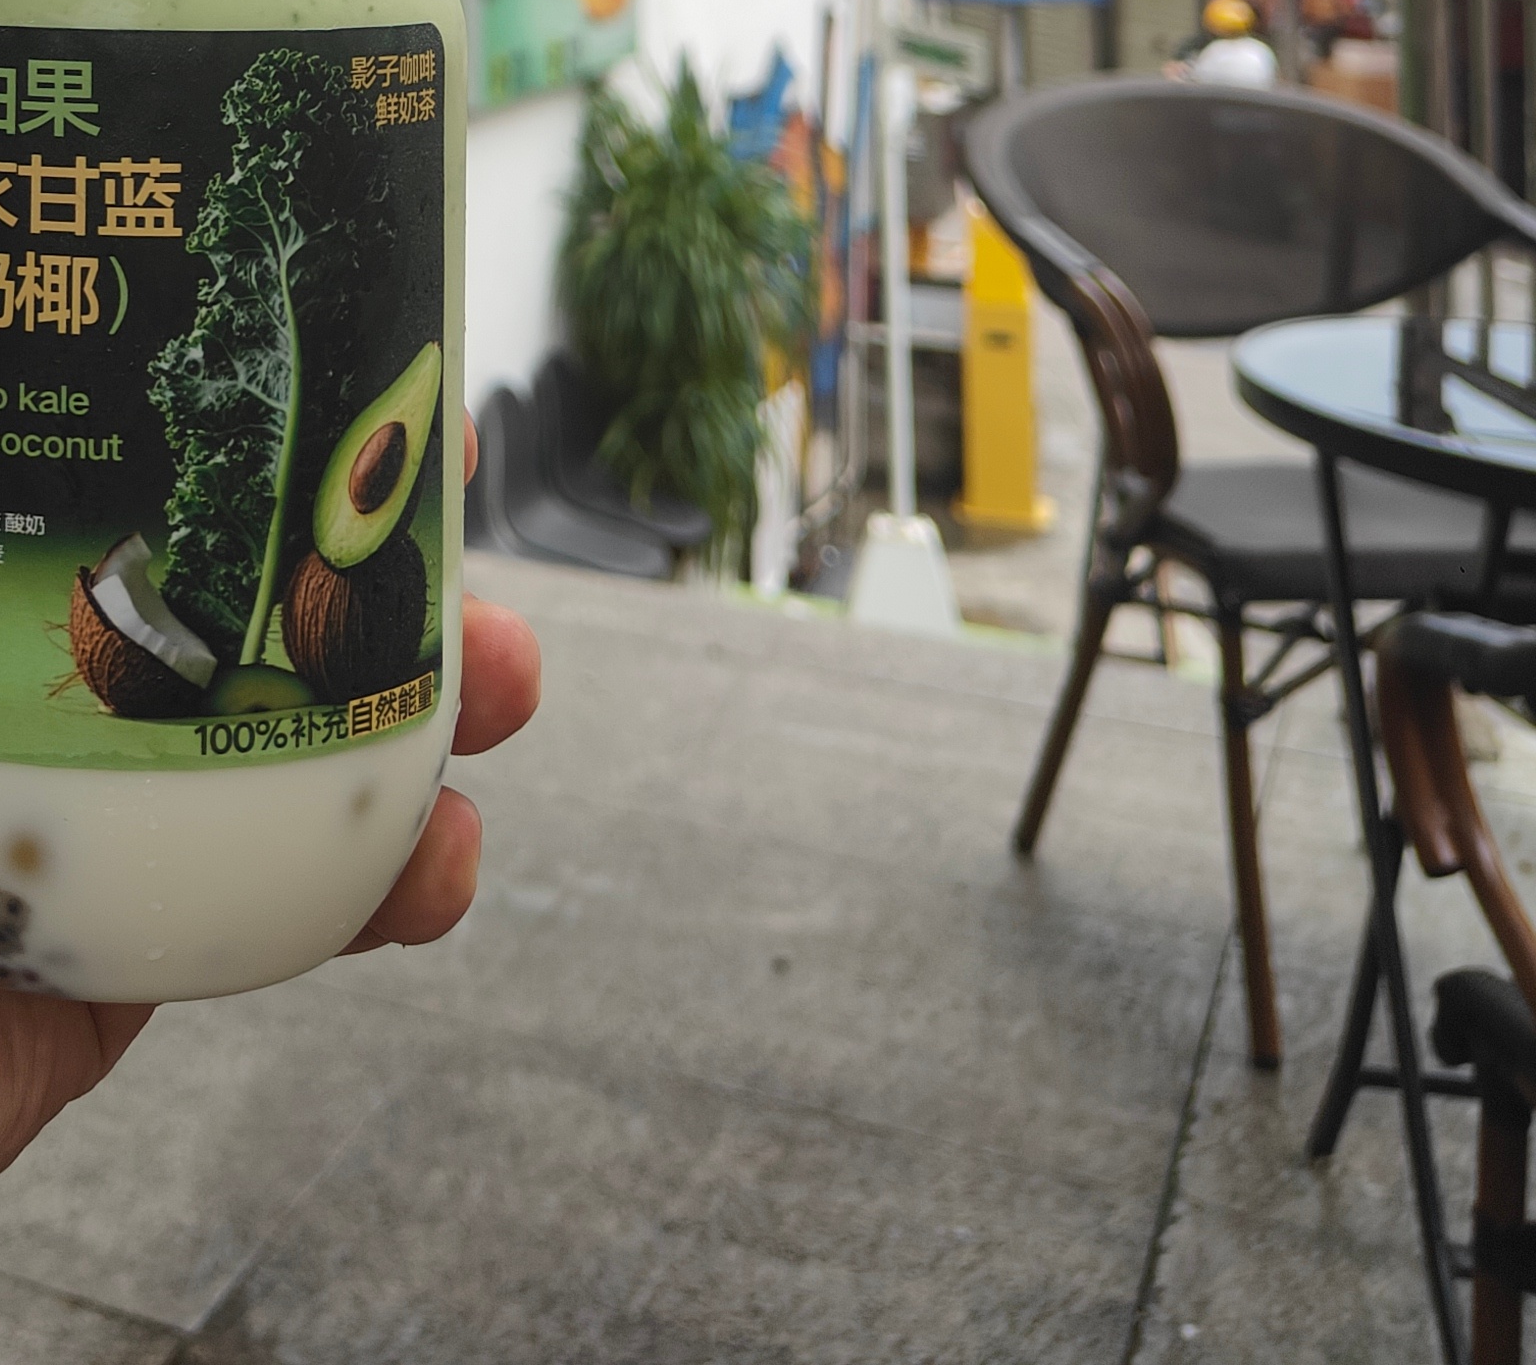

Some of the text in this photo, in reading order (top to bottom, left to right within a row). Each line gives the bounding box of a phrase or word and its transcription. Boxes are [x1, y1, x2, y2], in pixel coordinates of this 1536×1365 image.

[350, 49, 436, 89] 影子咖啡
[375, 87, 436, 127] 鲜奶茶
[17, 382, 91, 417] kale
[4, 512, 46, 536] 酸奶
